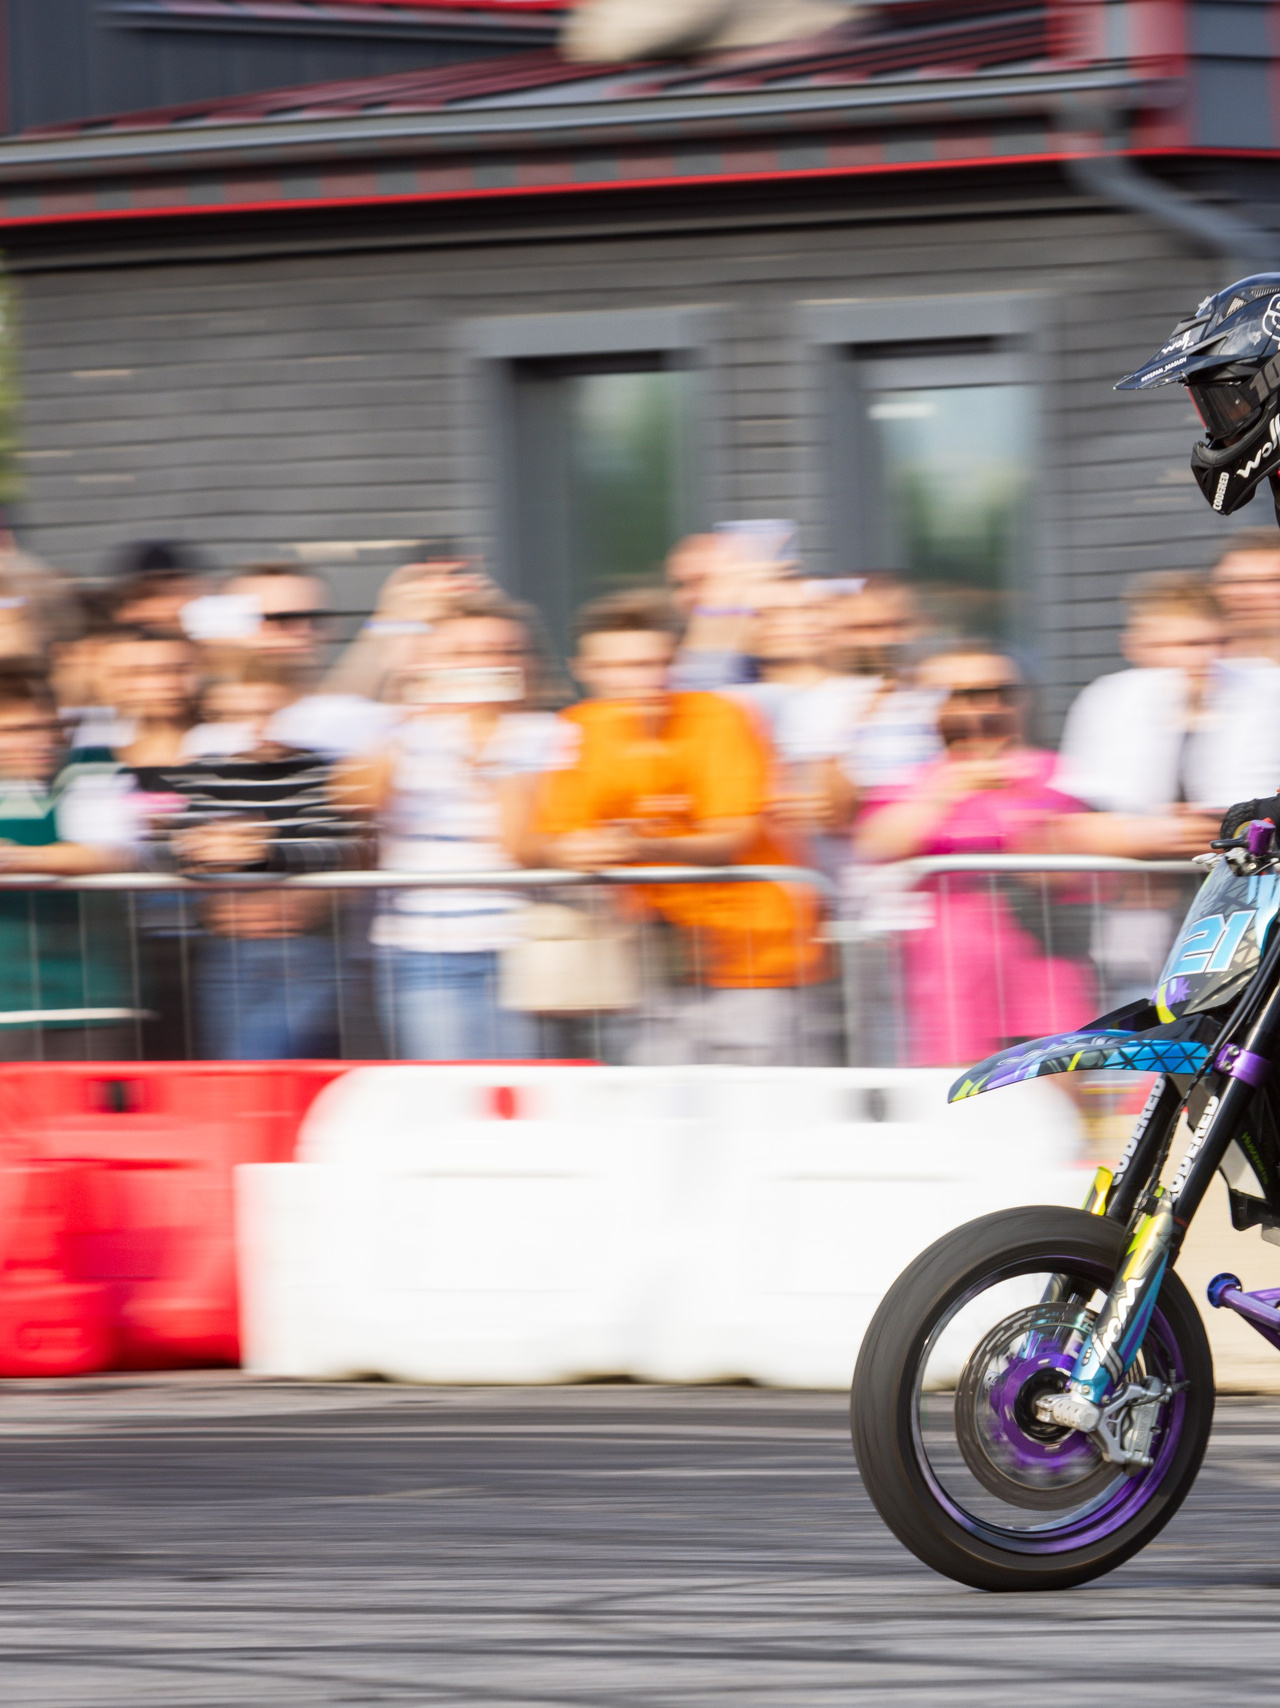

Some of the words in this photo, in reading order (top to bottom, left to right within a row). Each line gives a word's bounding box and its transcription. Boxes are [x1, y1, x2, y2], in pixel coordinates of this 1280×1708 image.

[1212, 471, 1230, 511] CODERED
[1163, 910, 1257, 984] 21
[1171, 1096, 1220, 1203] ODERED
